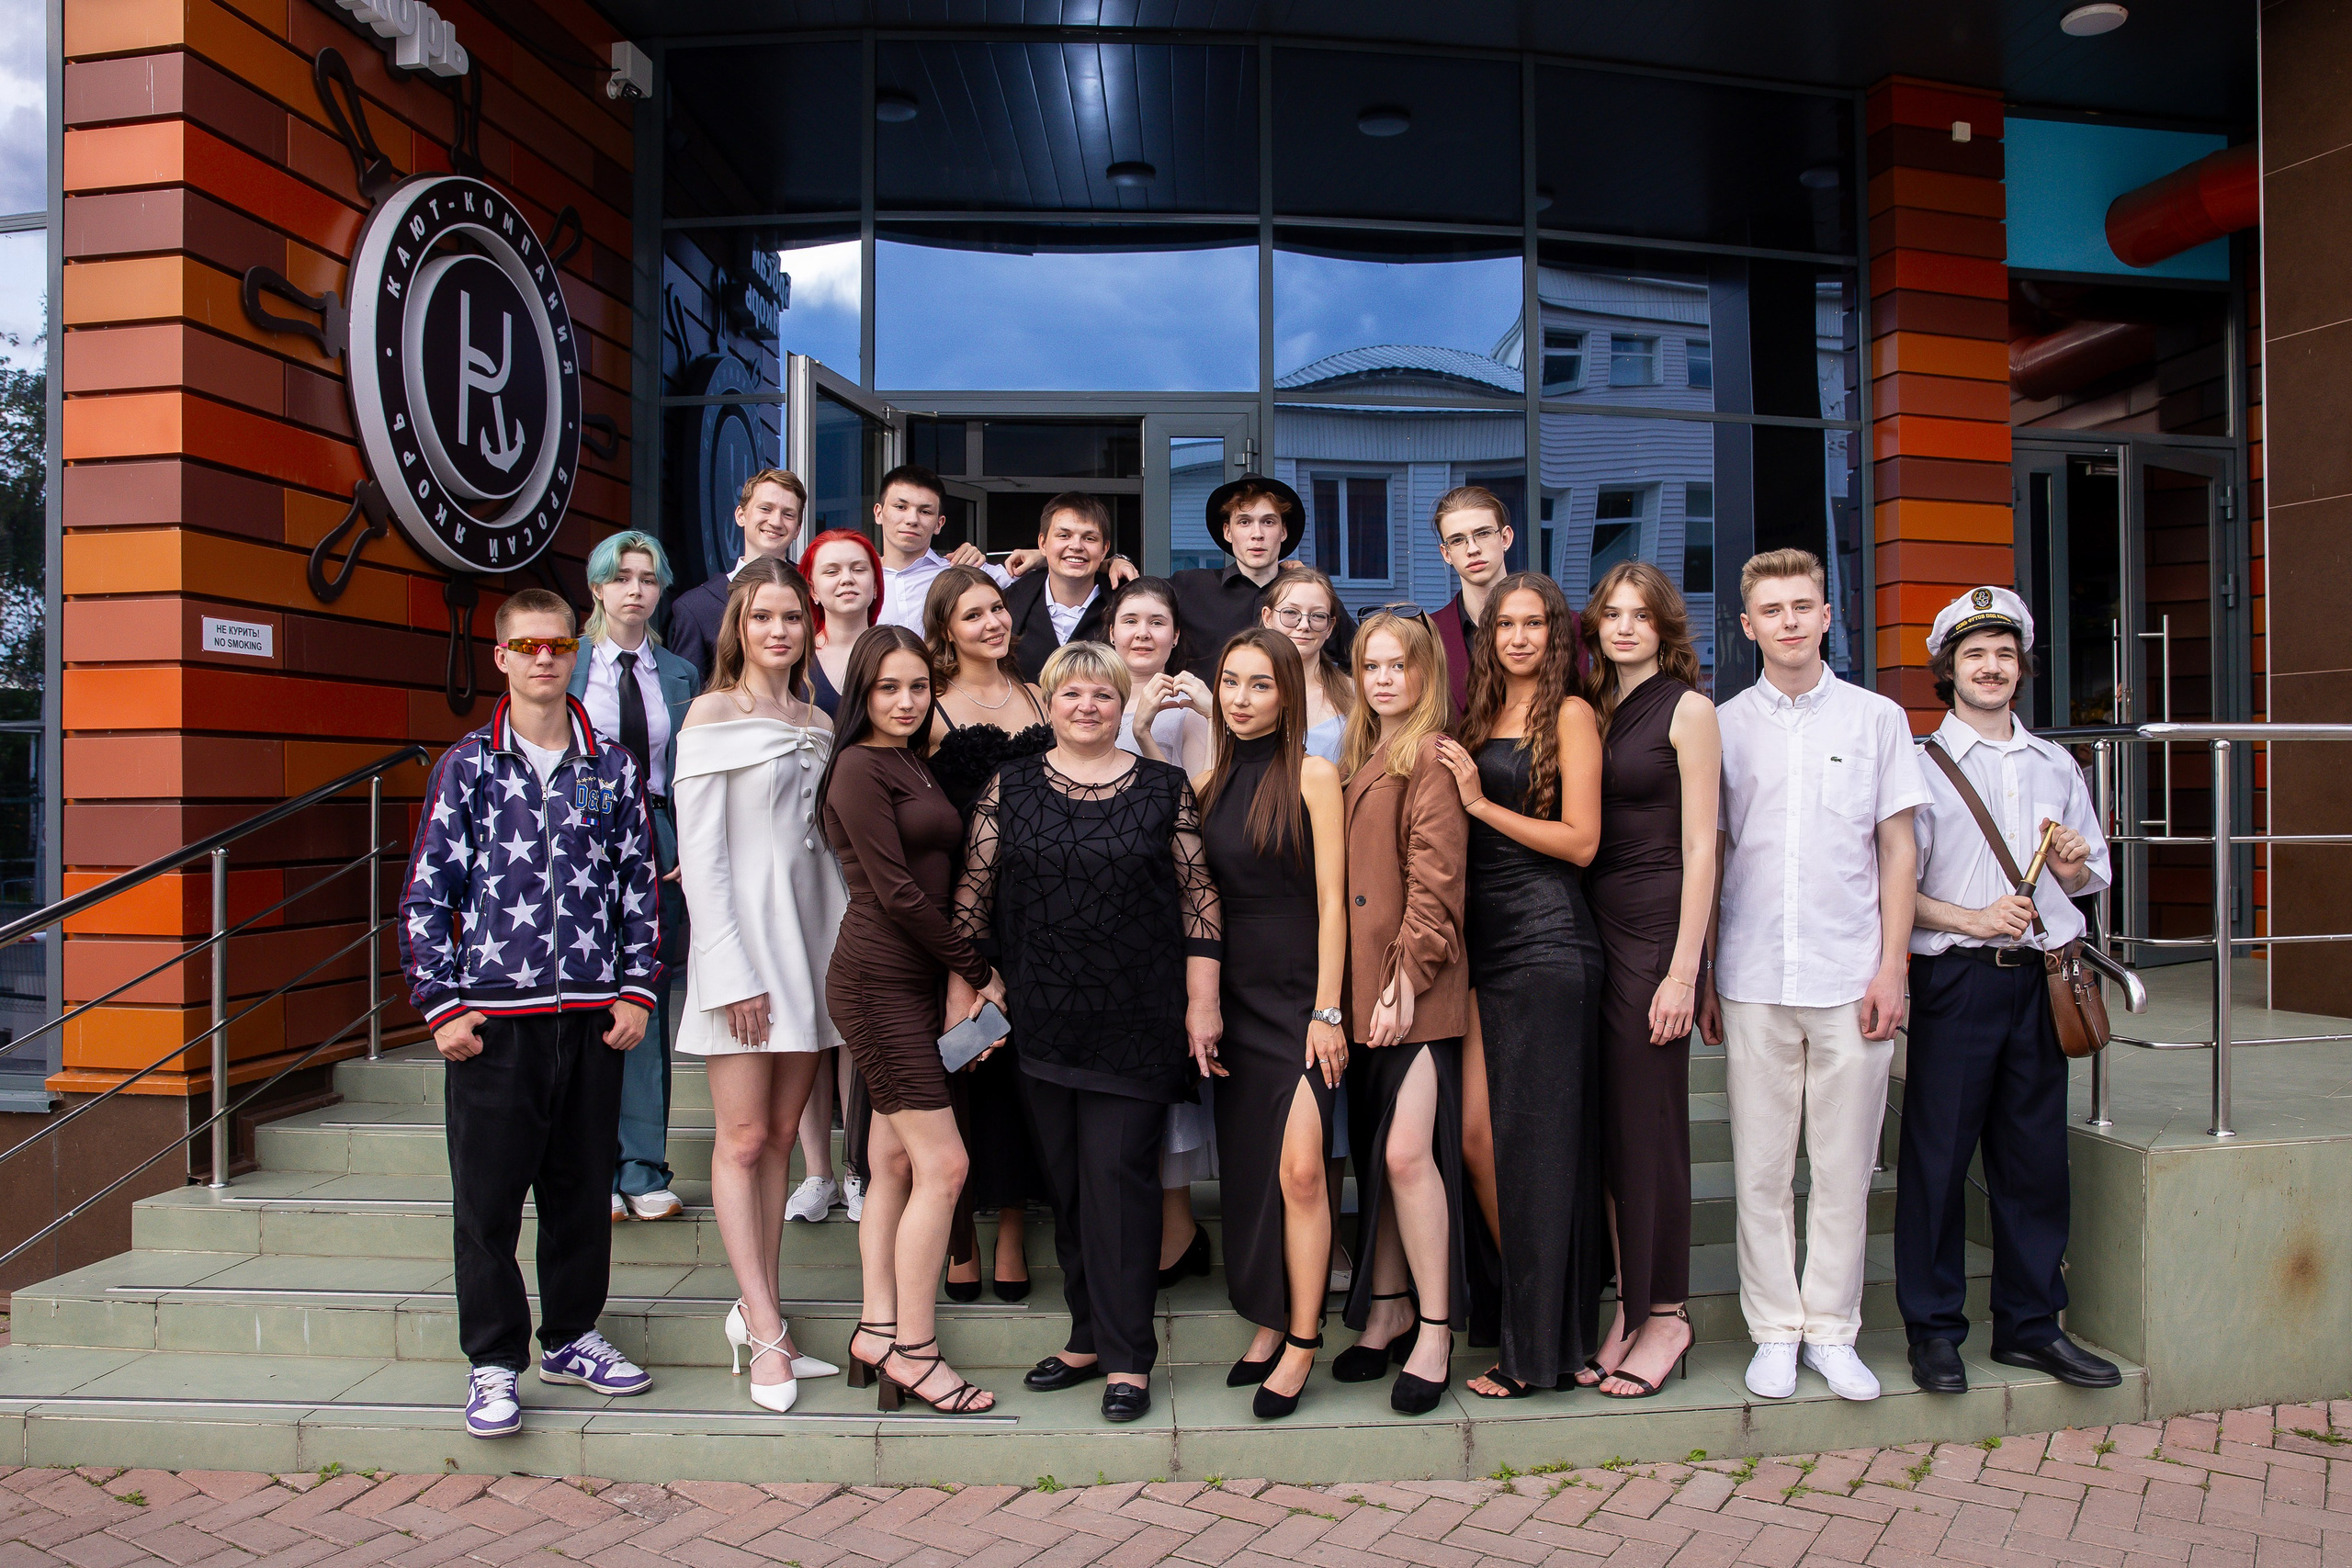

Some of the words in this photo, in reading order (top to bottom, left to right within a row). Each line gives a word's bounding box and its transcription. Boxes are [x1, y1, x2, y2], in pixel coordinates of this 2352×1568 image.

[336, 0, 469, 77] орь
[387, 191, 573, 375] КАЮТ-КОМПАНИЯ
[393, 413, 467, 544] ЯКОРЬ
[489, 467, 568, 563] БРОСАЙ
[214, 637, 226, 647] NO
[228, 639, 263, 650] SMOKING
[217, 625, 227, 634] НЕ
[229, 626, 260, 637] КУРИТЬ!
[575, 784, 614, 815] D&G
